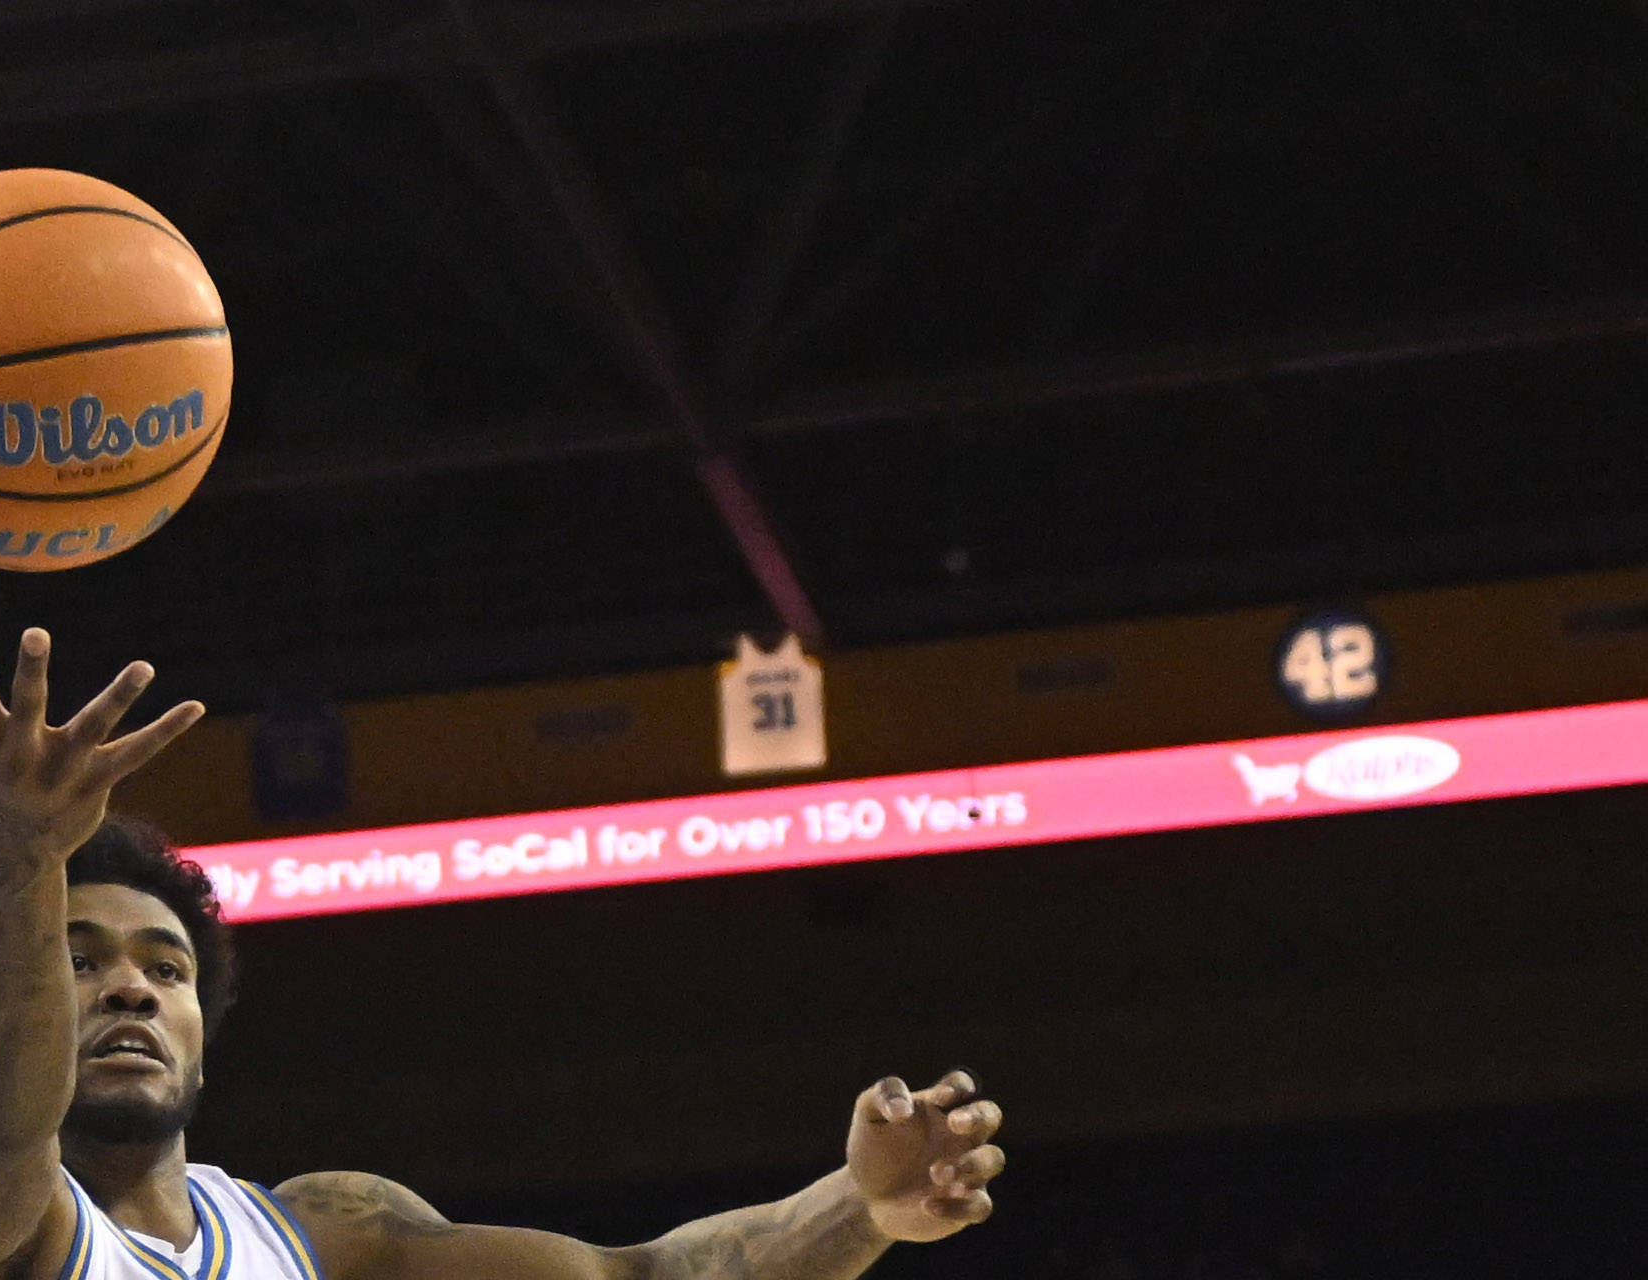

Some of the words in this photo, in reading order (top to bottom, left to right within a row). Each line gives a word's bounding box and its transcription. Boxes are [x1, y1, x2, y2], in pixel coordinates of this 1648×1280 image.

[1282, 624, 1378, 704] 42
[752, 690, 796, 731] 31
[270, 848, 443, 899] Serving
[453, 826, 587, 881] SoCal
[596, 823, 667, 865] for
[677, 814, 793, 858] Over
[802, 798, 886, 844] 150
[896, 790, 1028, 835] Years
